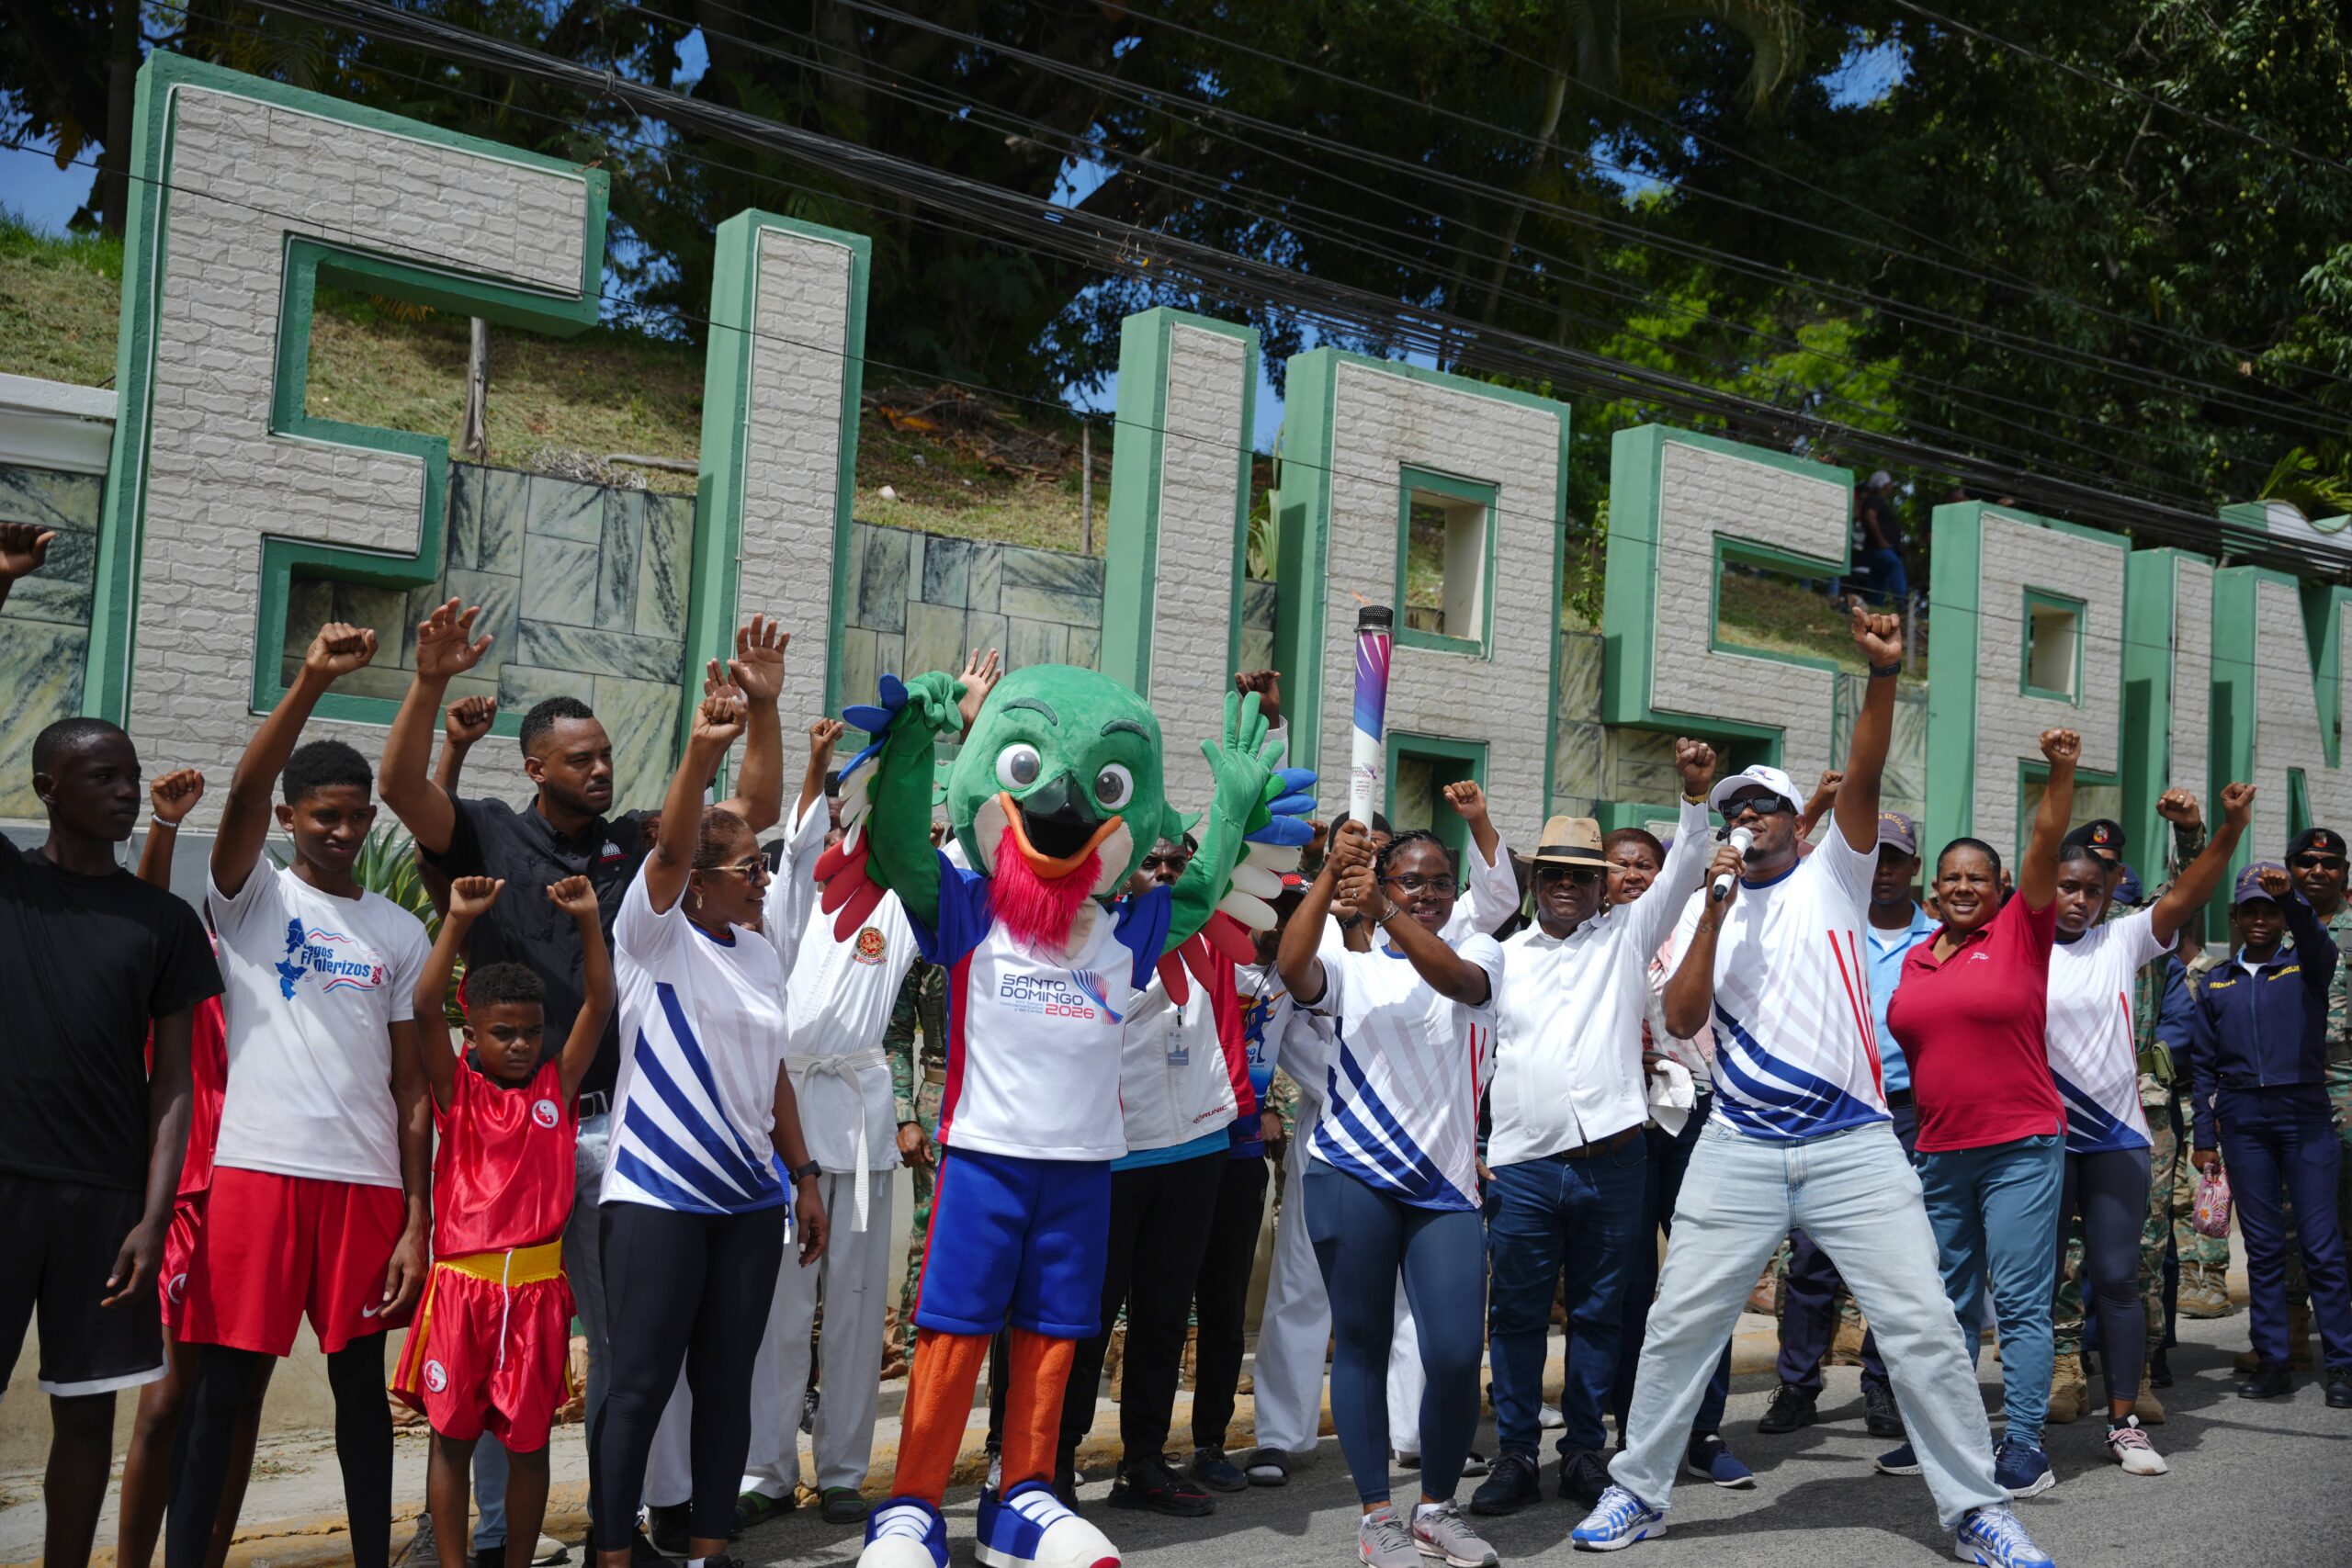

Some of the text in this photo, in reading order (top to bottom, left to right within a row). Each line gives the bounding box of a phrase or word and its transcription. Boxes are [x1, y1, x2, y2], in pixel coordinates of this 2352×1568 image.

[1001, 974, 1067, 992] SANTO
[1001, 986, 1084, 1006] DOMINGO
[1045, 1003, 1095, 1020] 2026
